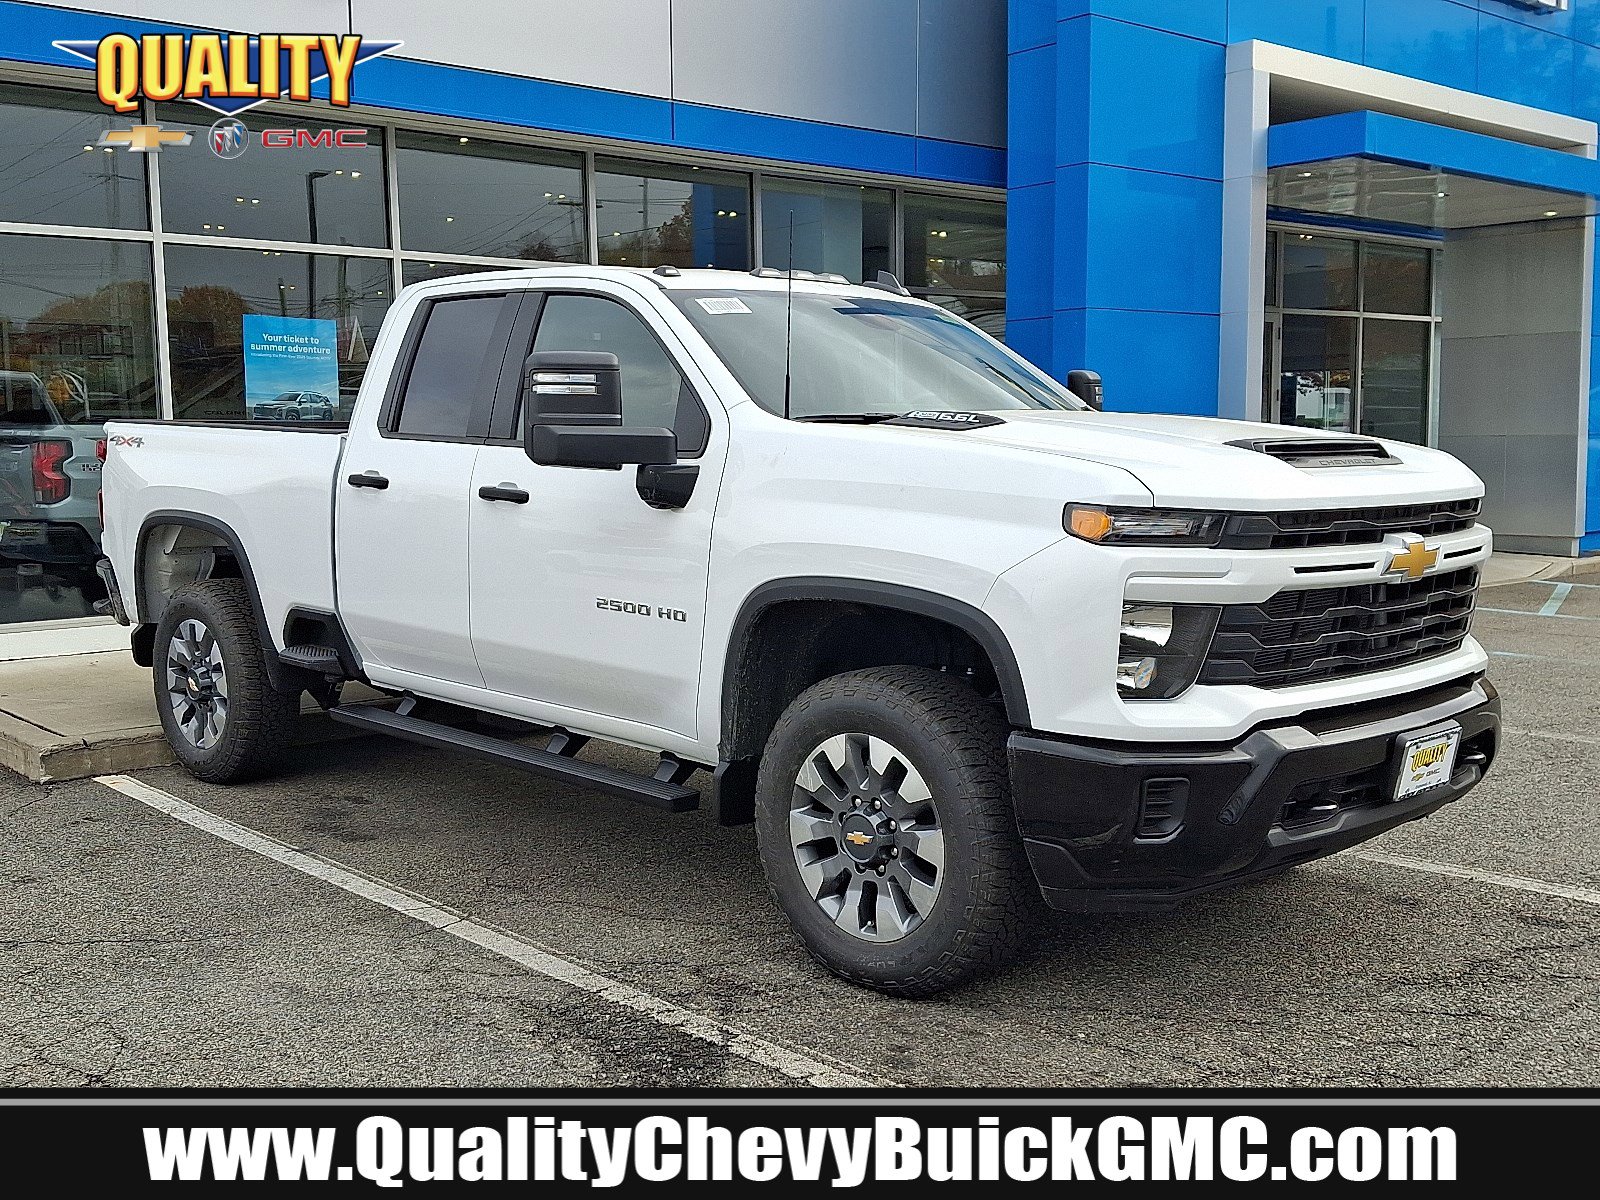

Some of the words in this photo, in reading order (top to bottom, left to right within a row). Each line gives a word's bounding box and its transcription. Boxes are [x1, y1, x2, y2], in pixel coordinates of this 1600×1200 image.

[262, 333, 282, 342] Your
[283, 334, 308, 344] ticket
[310, 337, 320, 345] to
[250, 343, 286, 352] summer
[287, 345, 331, 354] adventure
[1318, 458, 1377, 466] CHEVROLET
[595, 597, 652, 617] 2500
[657, 606, 688, 623] HD
[1411, 743, 1448, 772] QUALITY
